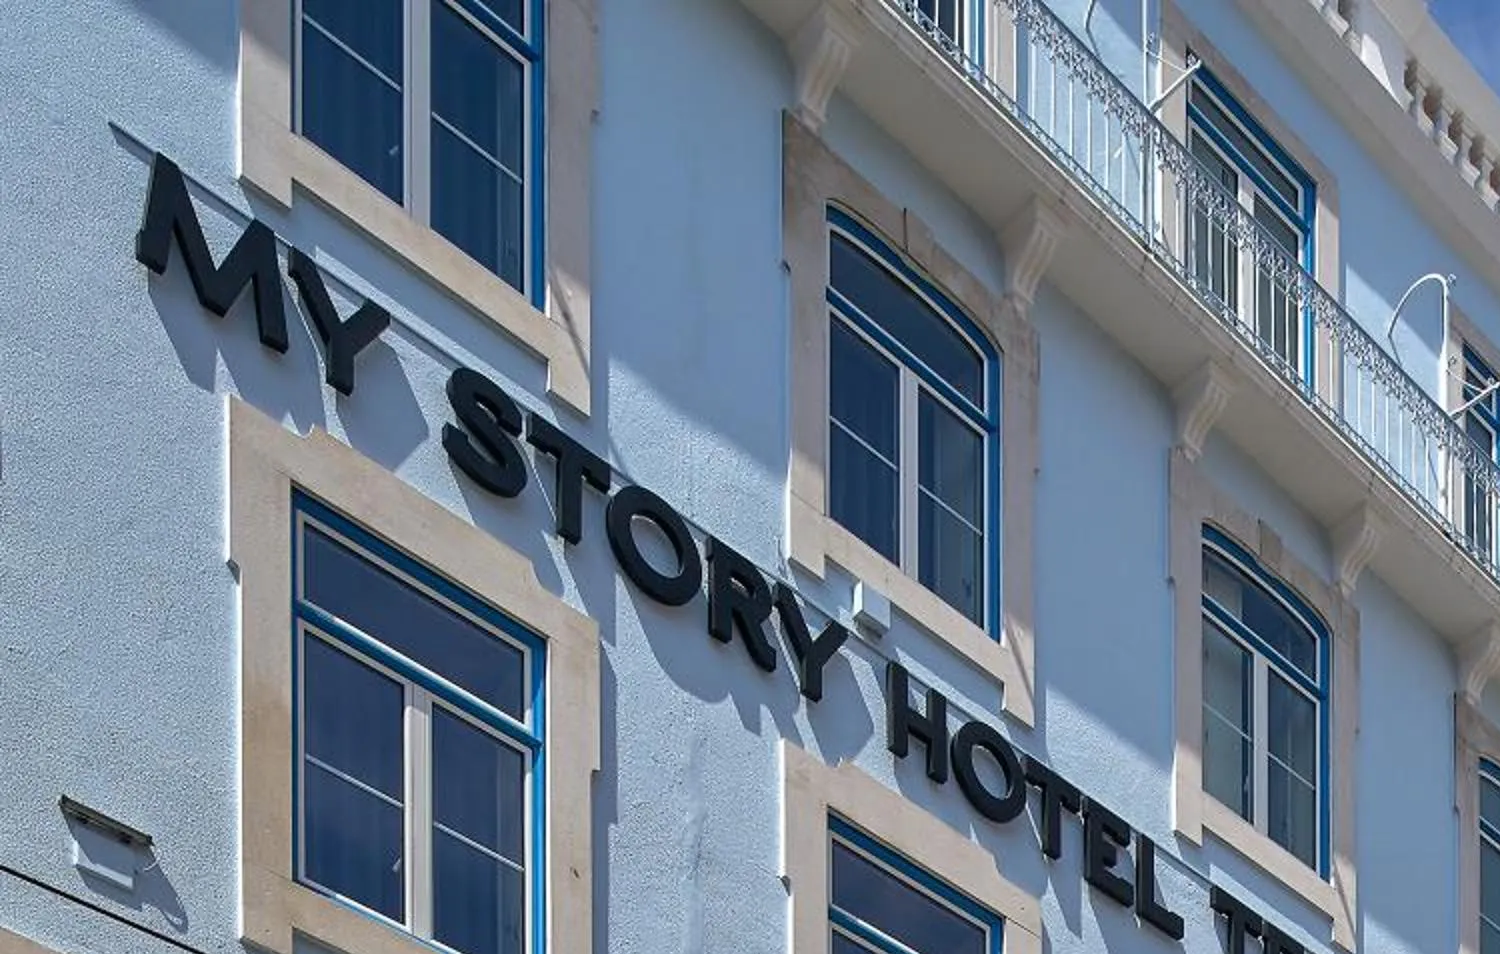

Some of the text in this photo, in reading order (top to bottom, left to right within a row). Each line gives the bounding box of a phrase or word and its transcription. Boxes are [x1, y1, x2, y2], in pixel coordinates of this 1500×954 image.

[136, 151, 391, 396] MY
[442, 367, 848, 702] STORY
[887, 660, 1184, 941] HOTEL
